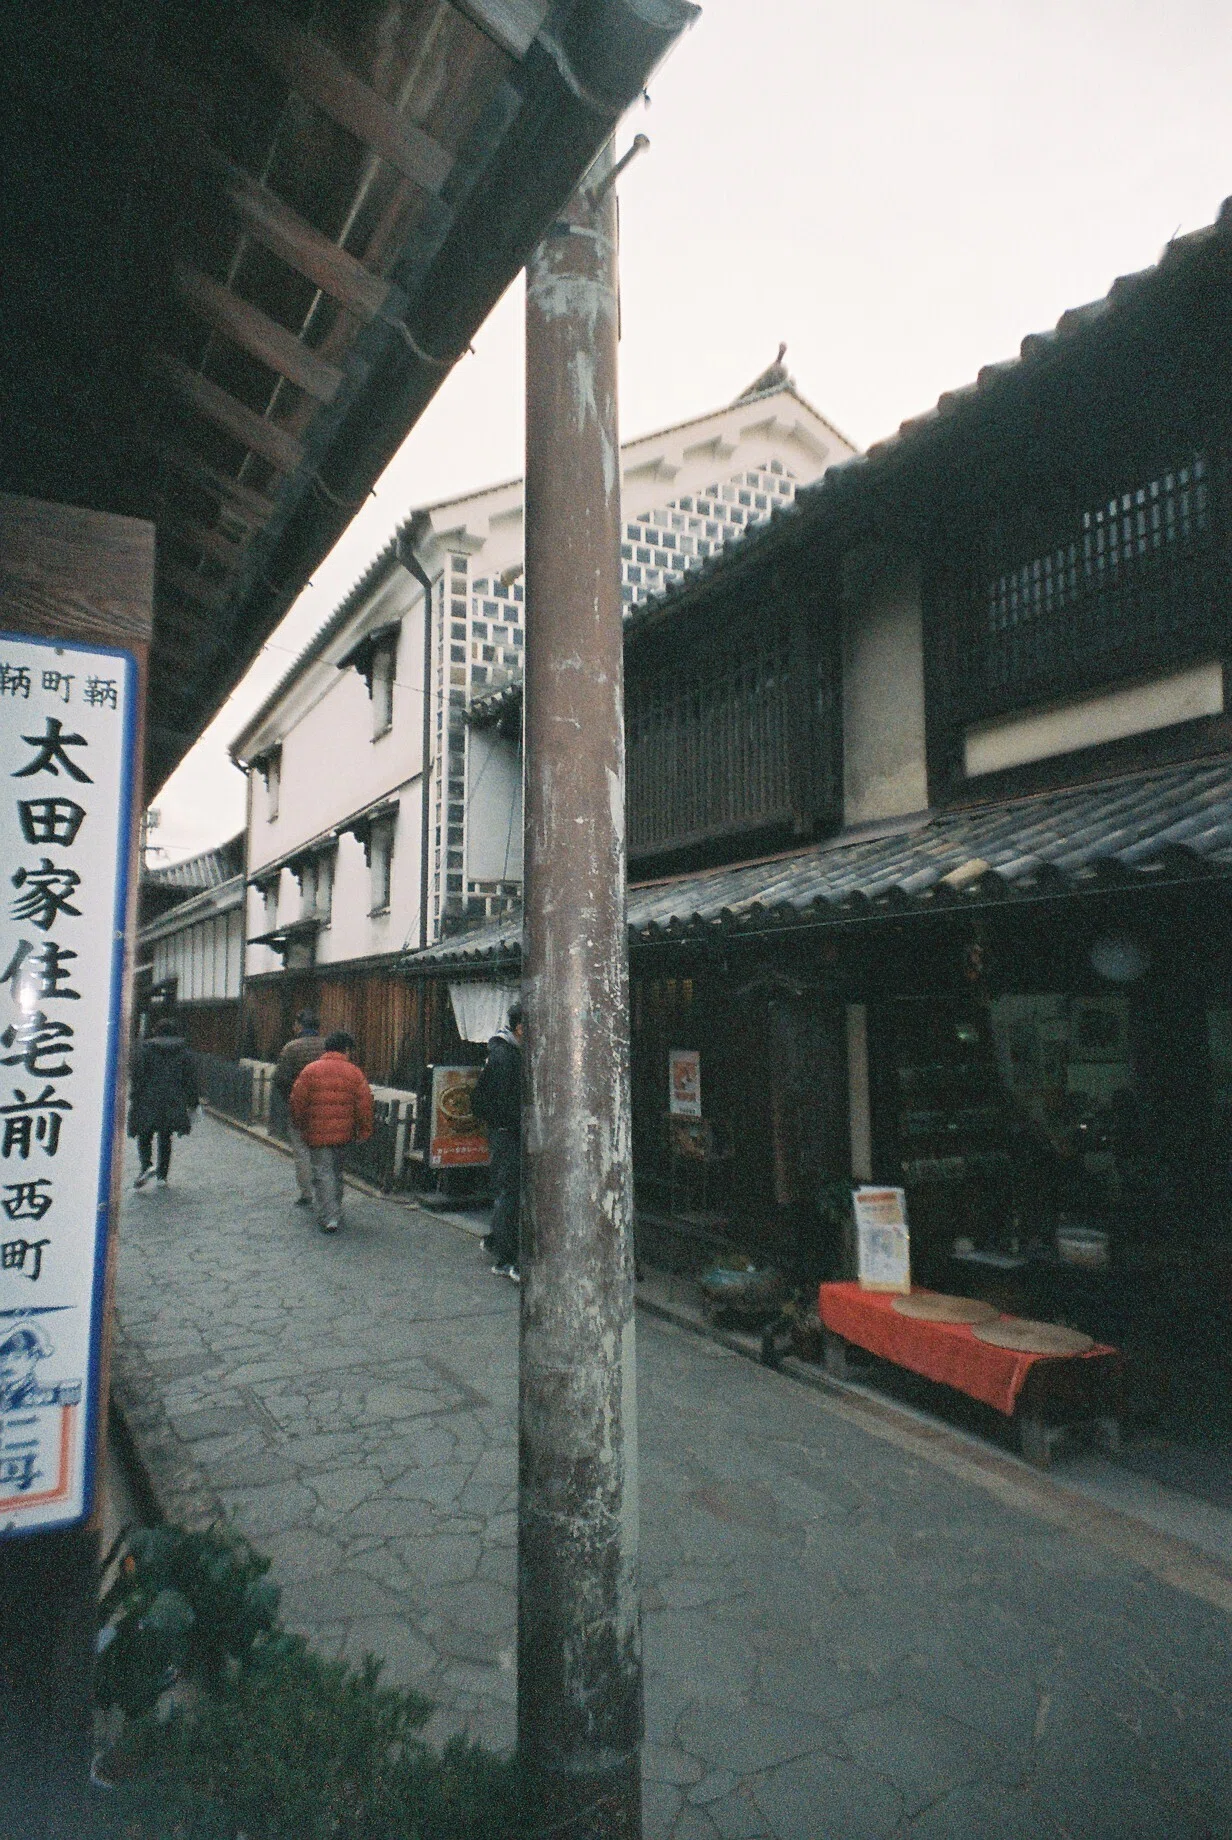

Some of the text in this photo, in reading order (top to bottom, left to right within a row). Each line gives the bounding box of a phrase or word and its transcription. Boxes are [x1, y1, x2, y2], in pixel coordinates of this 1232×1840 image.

[0, 717, 95, 1160] 太田家住宅前
[1, 1178, 53, 1282] 西町
